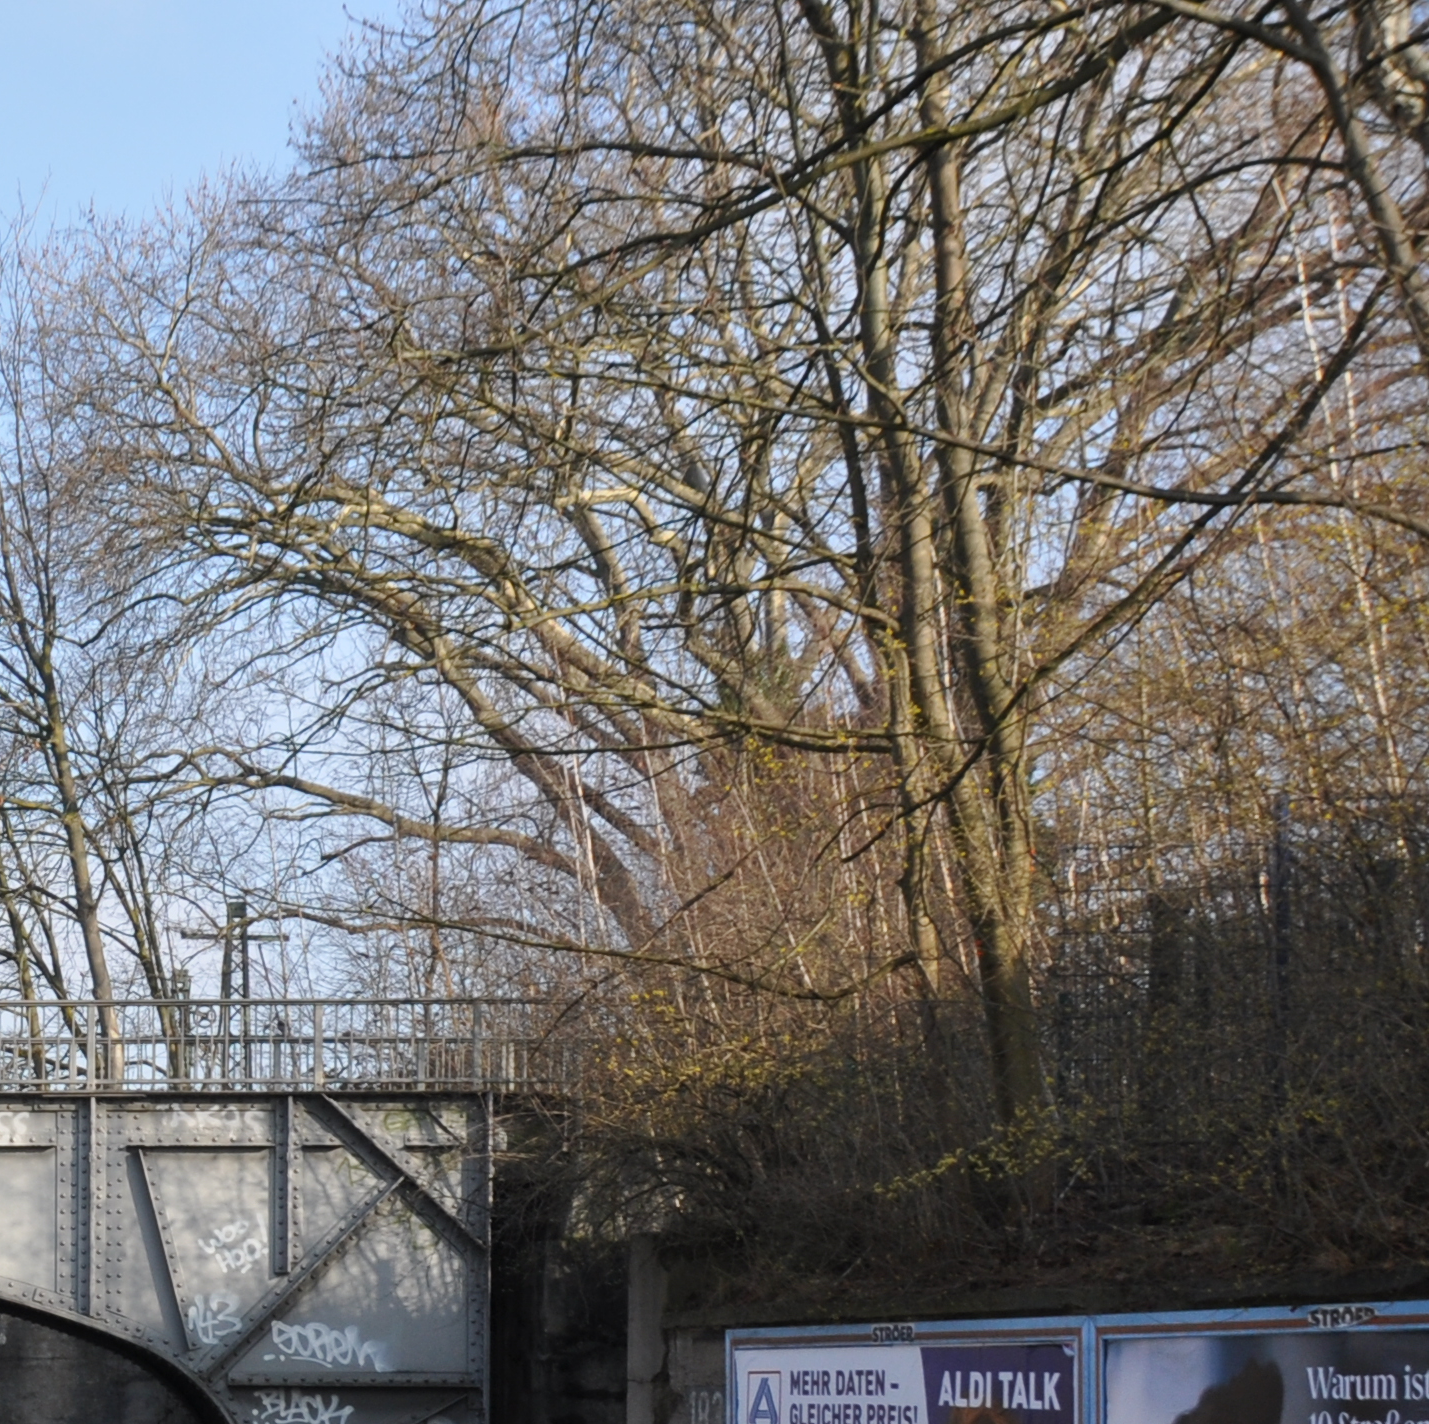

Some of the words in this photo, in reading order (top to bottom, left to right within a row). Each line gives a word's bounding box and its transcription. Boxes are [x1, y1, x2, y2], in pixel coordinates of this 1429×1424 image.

[872, 1326, 914, 1343] STRÖER
[790, 1370, 831, 1396] MEHR
[836, 1370, 885, 1396] DATEN
[938, 1370, 992, 1408] ALDI
[998, 1371, 1061, 1411] TALK
[1306, 1366, 1397, 1400] Warum
